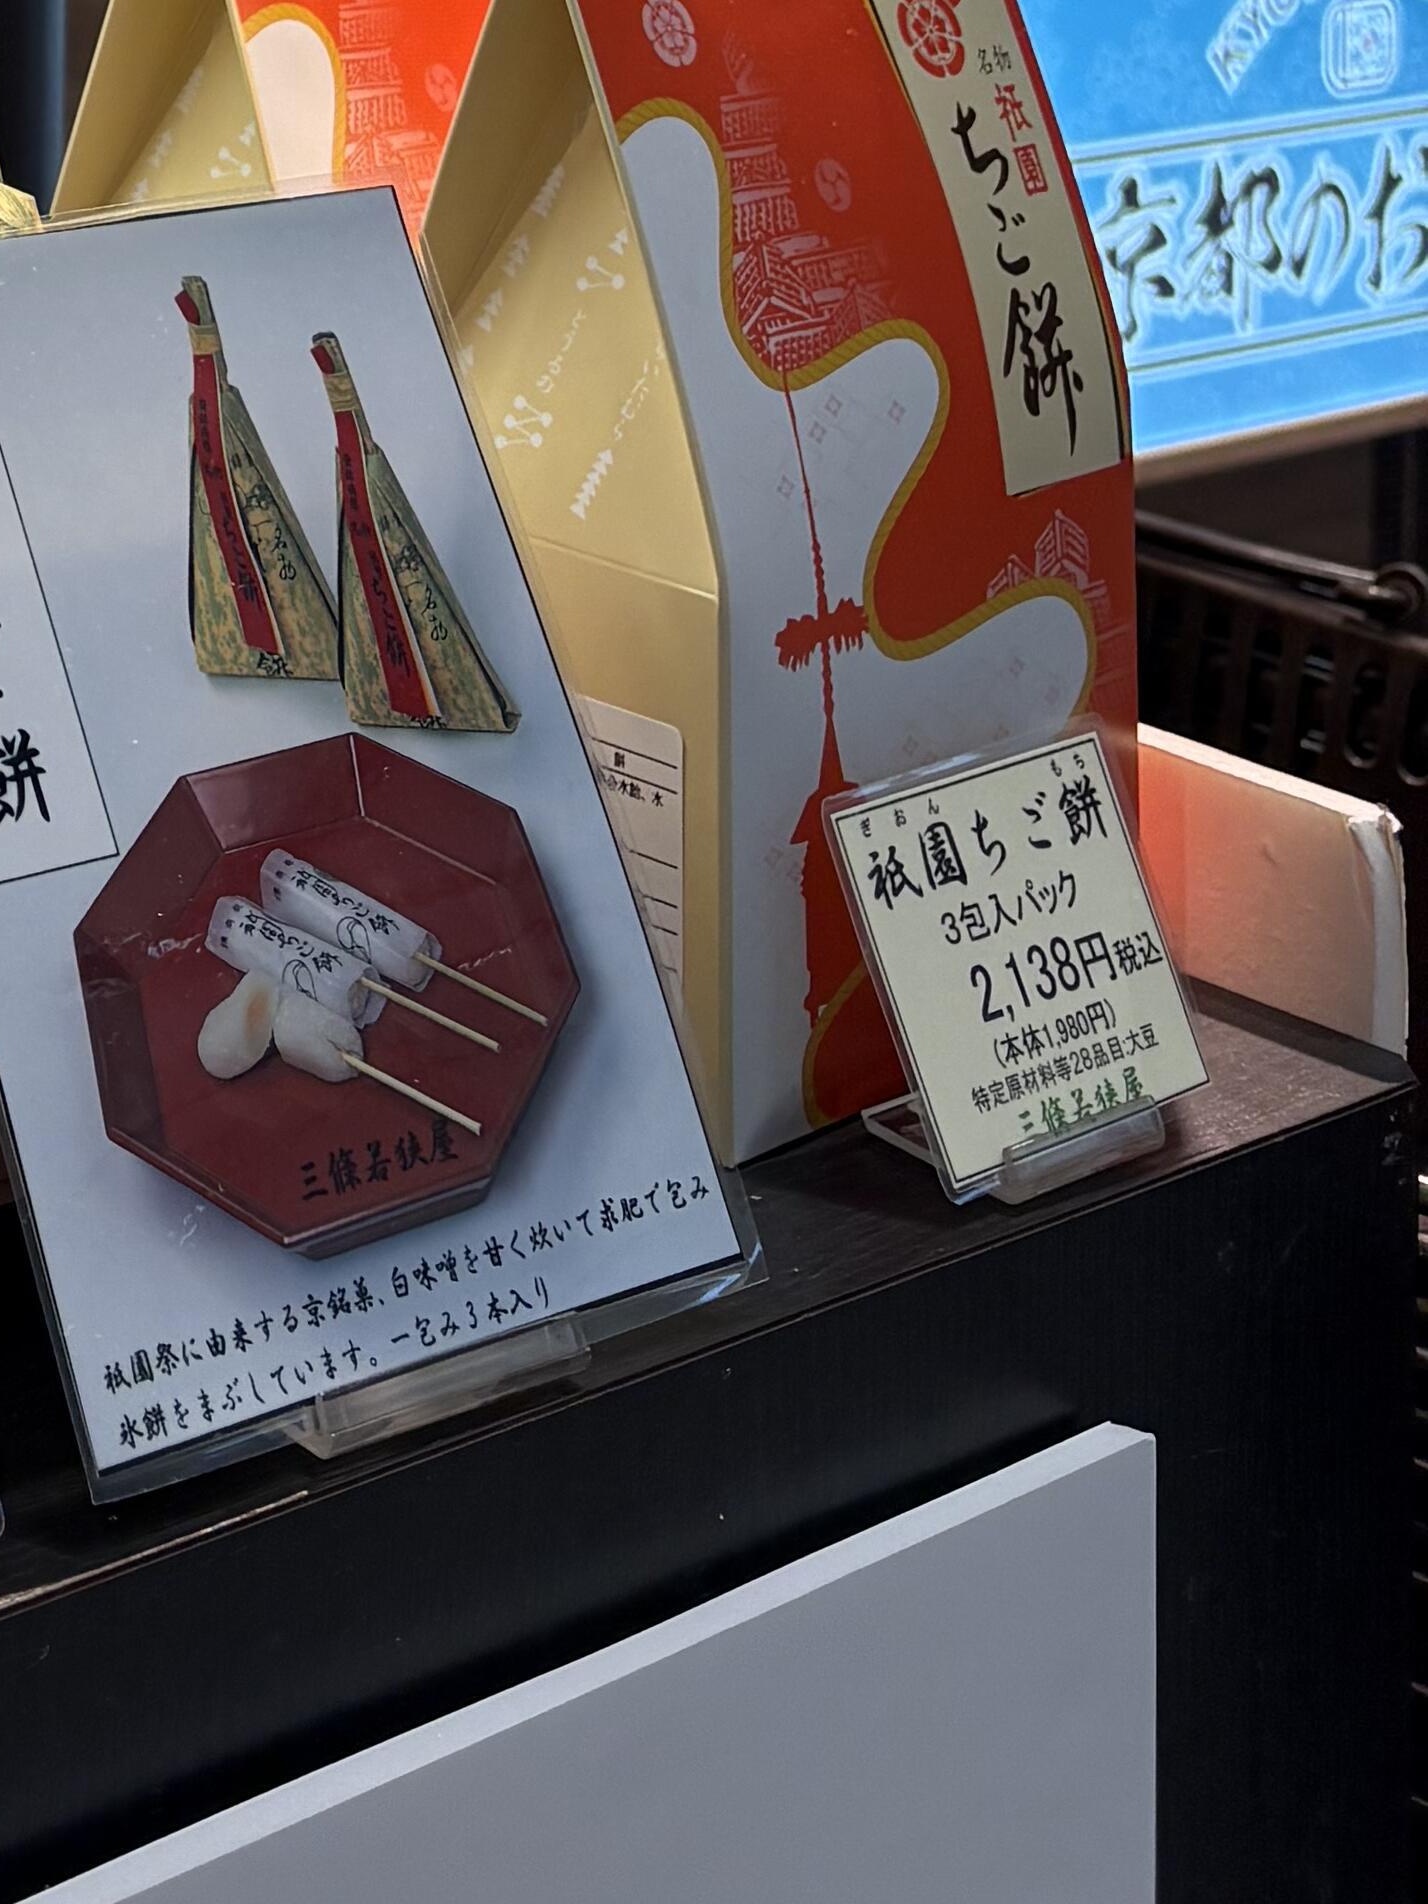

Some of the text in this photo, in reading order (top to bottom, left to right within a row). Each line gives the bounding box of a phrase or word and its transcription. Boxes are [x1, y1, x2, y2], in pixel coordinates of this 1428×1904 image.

[976, 42, 1013, 76] 名物
[993, 82, 1048, 197] 祇園
[950, 100, 1085, 458] ちご餅
[866, 774, 1110, 912] 祇園ちご餅
[940, 869, 1078, 947] 3包入パック
[993, 996, 1119, 1070] (本体1,980円)
[299, 1117, 461, 1203] 三條若狭屋
